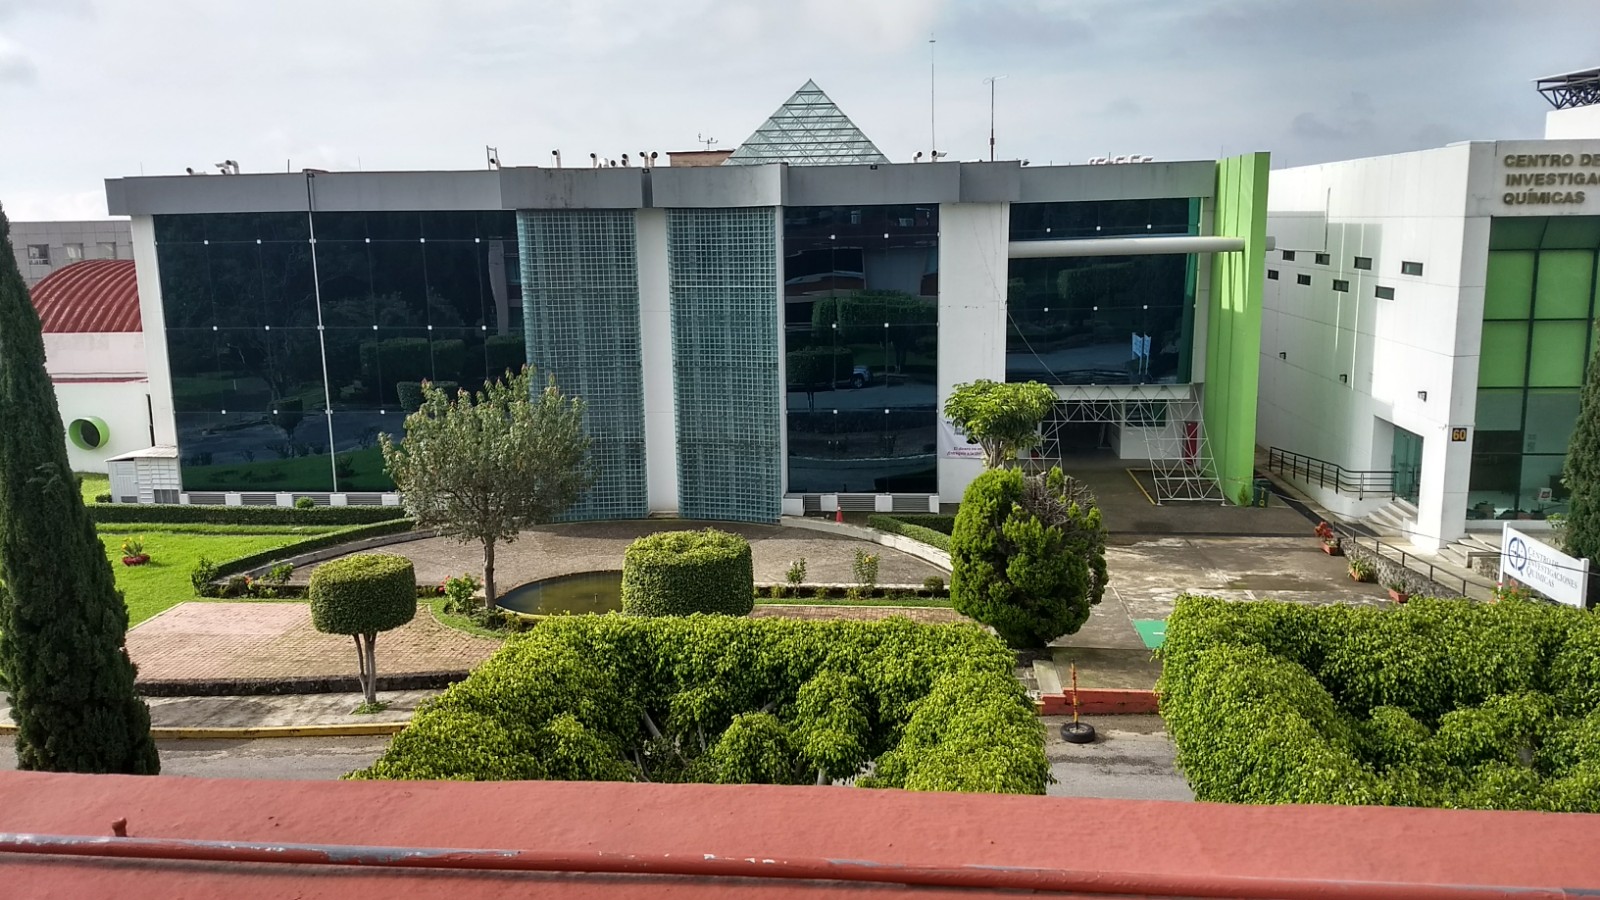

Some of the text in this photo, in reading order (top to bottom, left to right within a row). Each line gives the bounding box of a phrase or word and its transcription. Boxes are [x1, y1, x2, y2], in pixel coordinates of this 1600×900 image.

[1503, 153, 1600, 167] CENTRO DE
[1505, 172, 1600, 186] INVESTIGA
[1503, 188, 1586, 205] QUÍMICAS
[1453, 429, 1466, 441] 60
